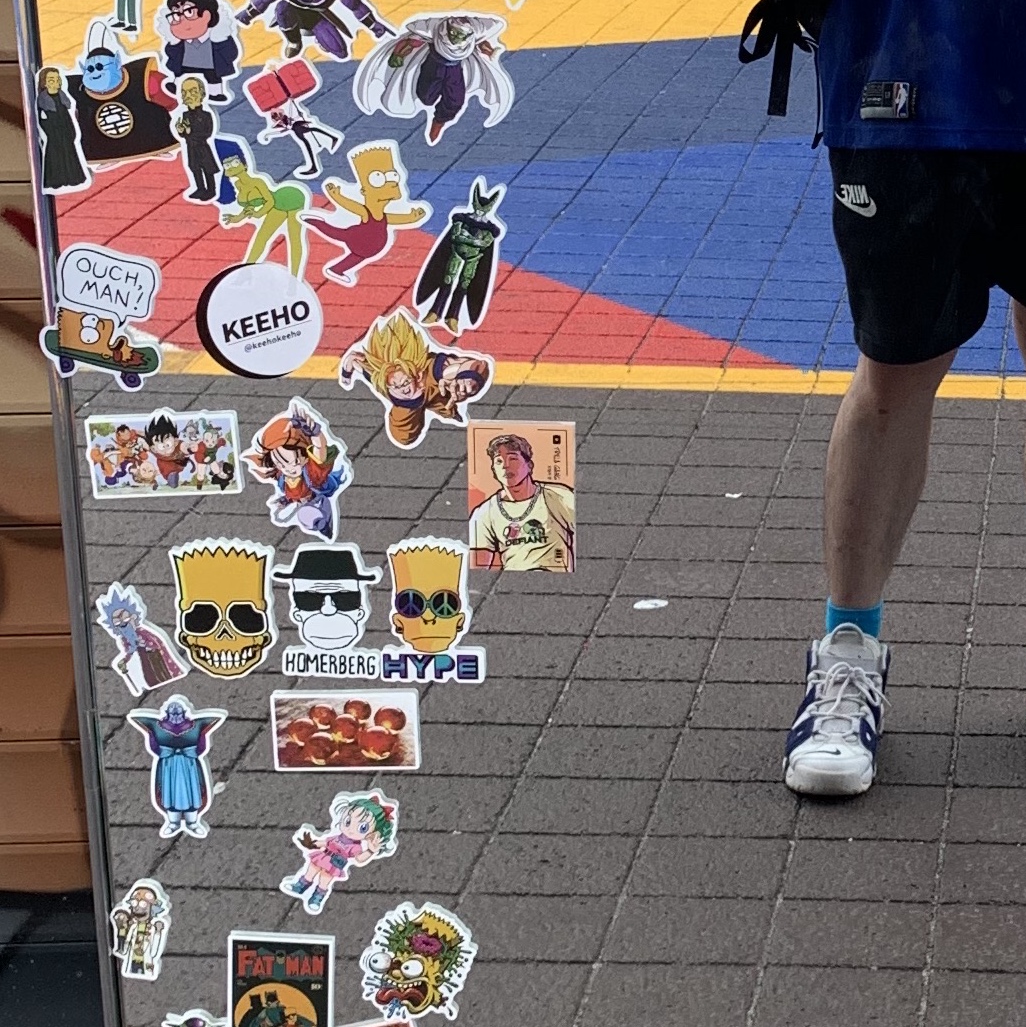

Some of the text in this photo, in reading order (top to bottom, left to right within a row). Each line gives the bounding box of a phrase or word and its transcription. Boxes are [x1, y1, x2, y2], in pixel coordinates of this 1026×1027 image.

[76, 257, 143, 291] OUCH,
[80, 280, 144, 311] MAN!
[222, 300, 311, 344] KEEHO
[244, 330, 302, 353] @keehokeeho
[505, 535, 550, 547] DEFIANT
[285, 652, 376, 675] HOMERBERG
[382, 653, 479, 680] HYPE
